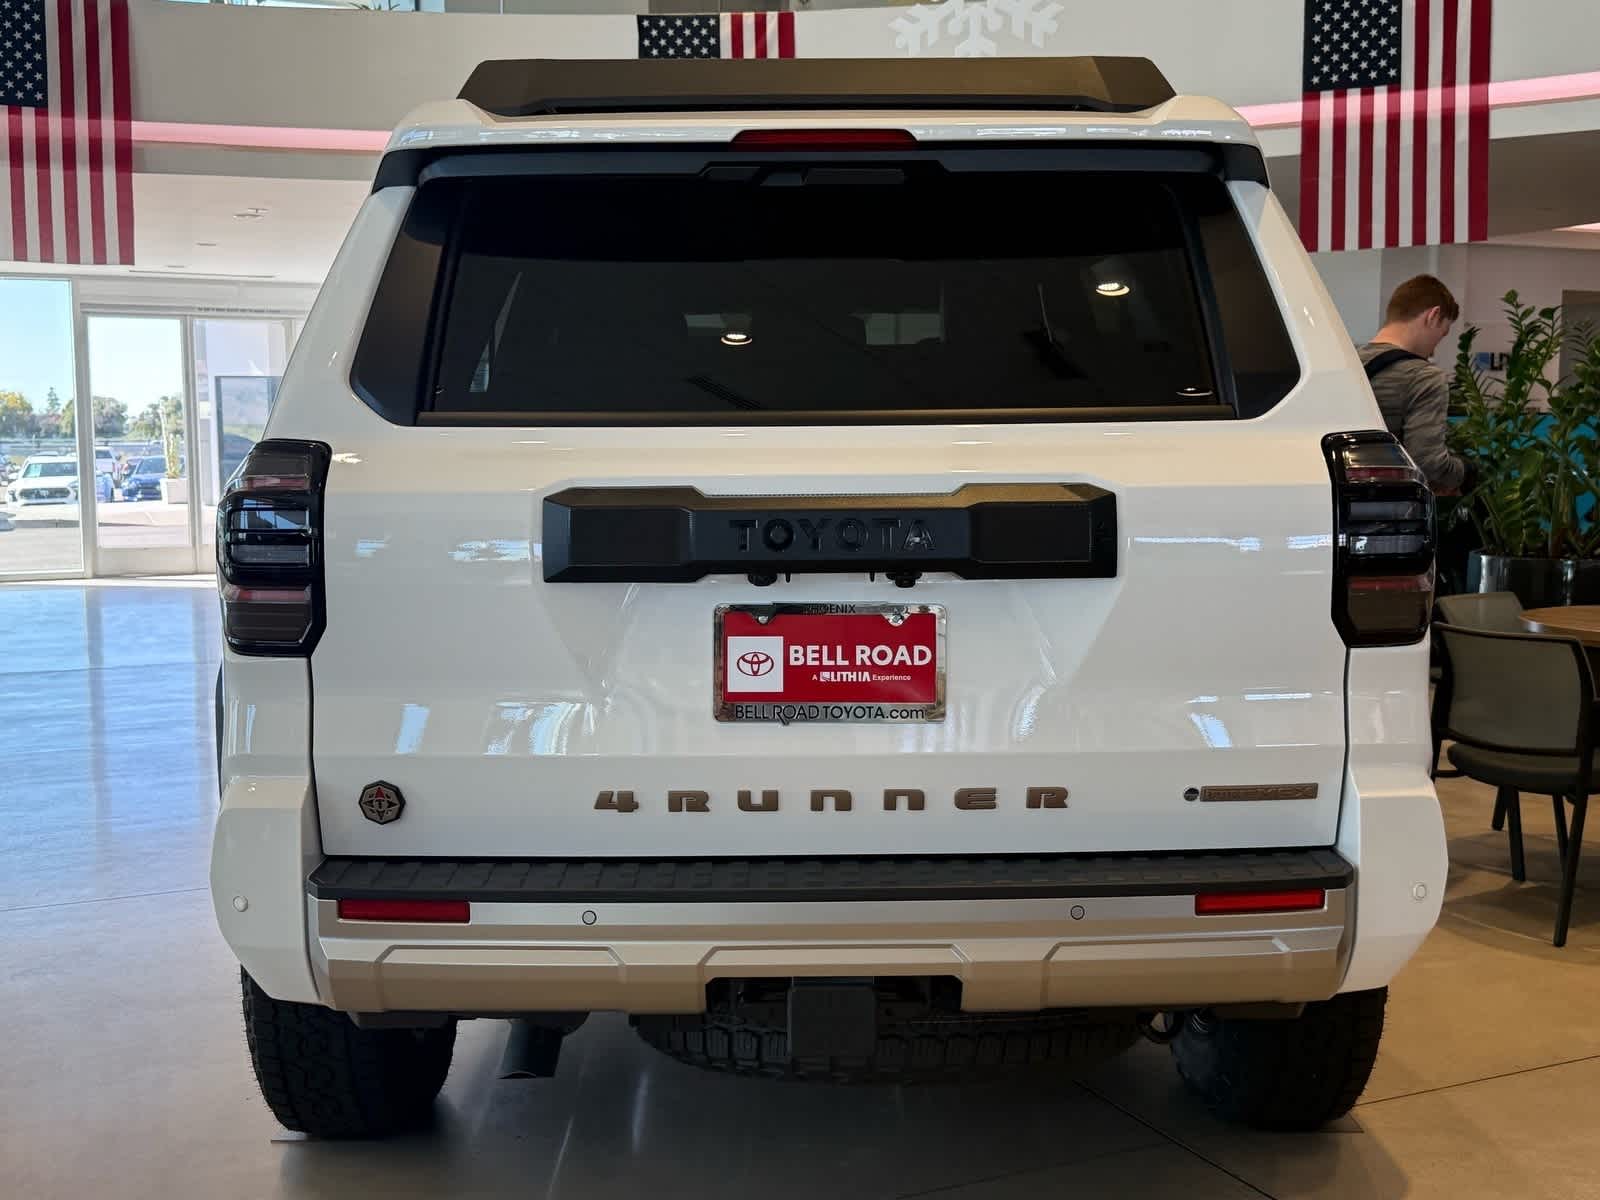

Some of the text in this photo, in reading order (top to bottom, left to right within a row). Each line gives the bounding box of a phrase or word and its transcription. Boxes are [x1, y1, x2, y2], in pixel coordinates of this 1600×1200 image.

[729, 518, 937, 552] TOYOTA
[789, 645, 932, 666] BELL ROAD
[831, 671, 871, 682] LITHIA
[872, 674, 911, 683] Experience
[735, 704, 925, 720] BELL ROAD TOYOTA.com
[594, 786, 1069, 813] 4RUNNER
